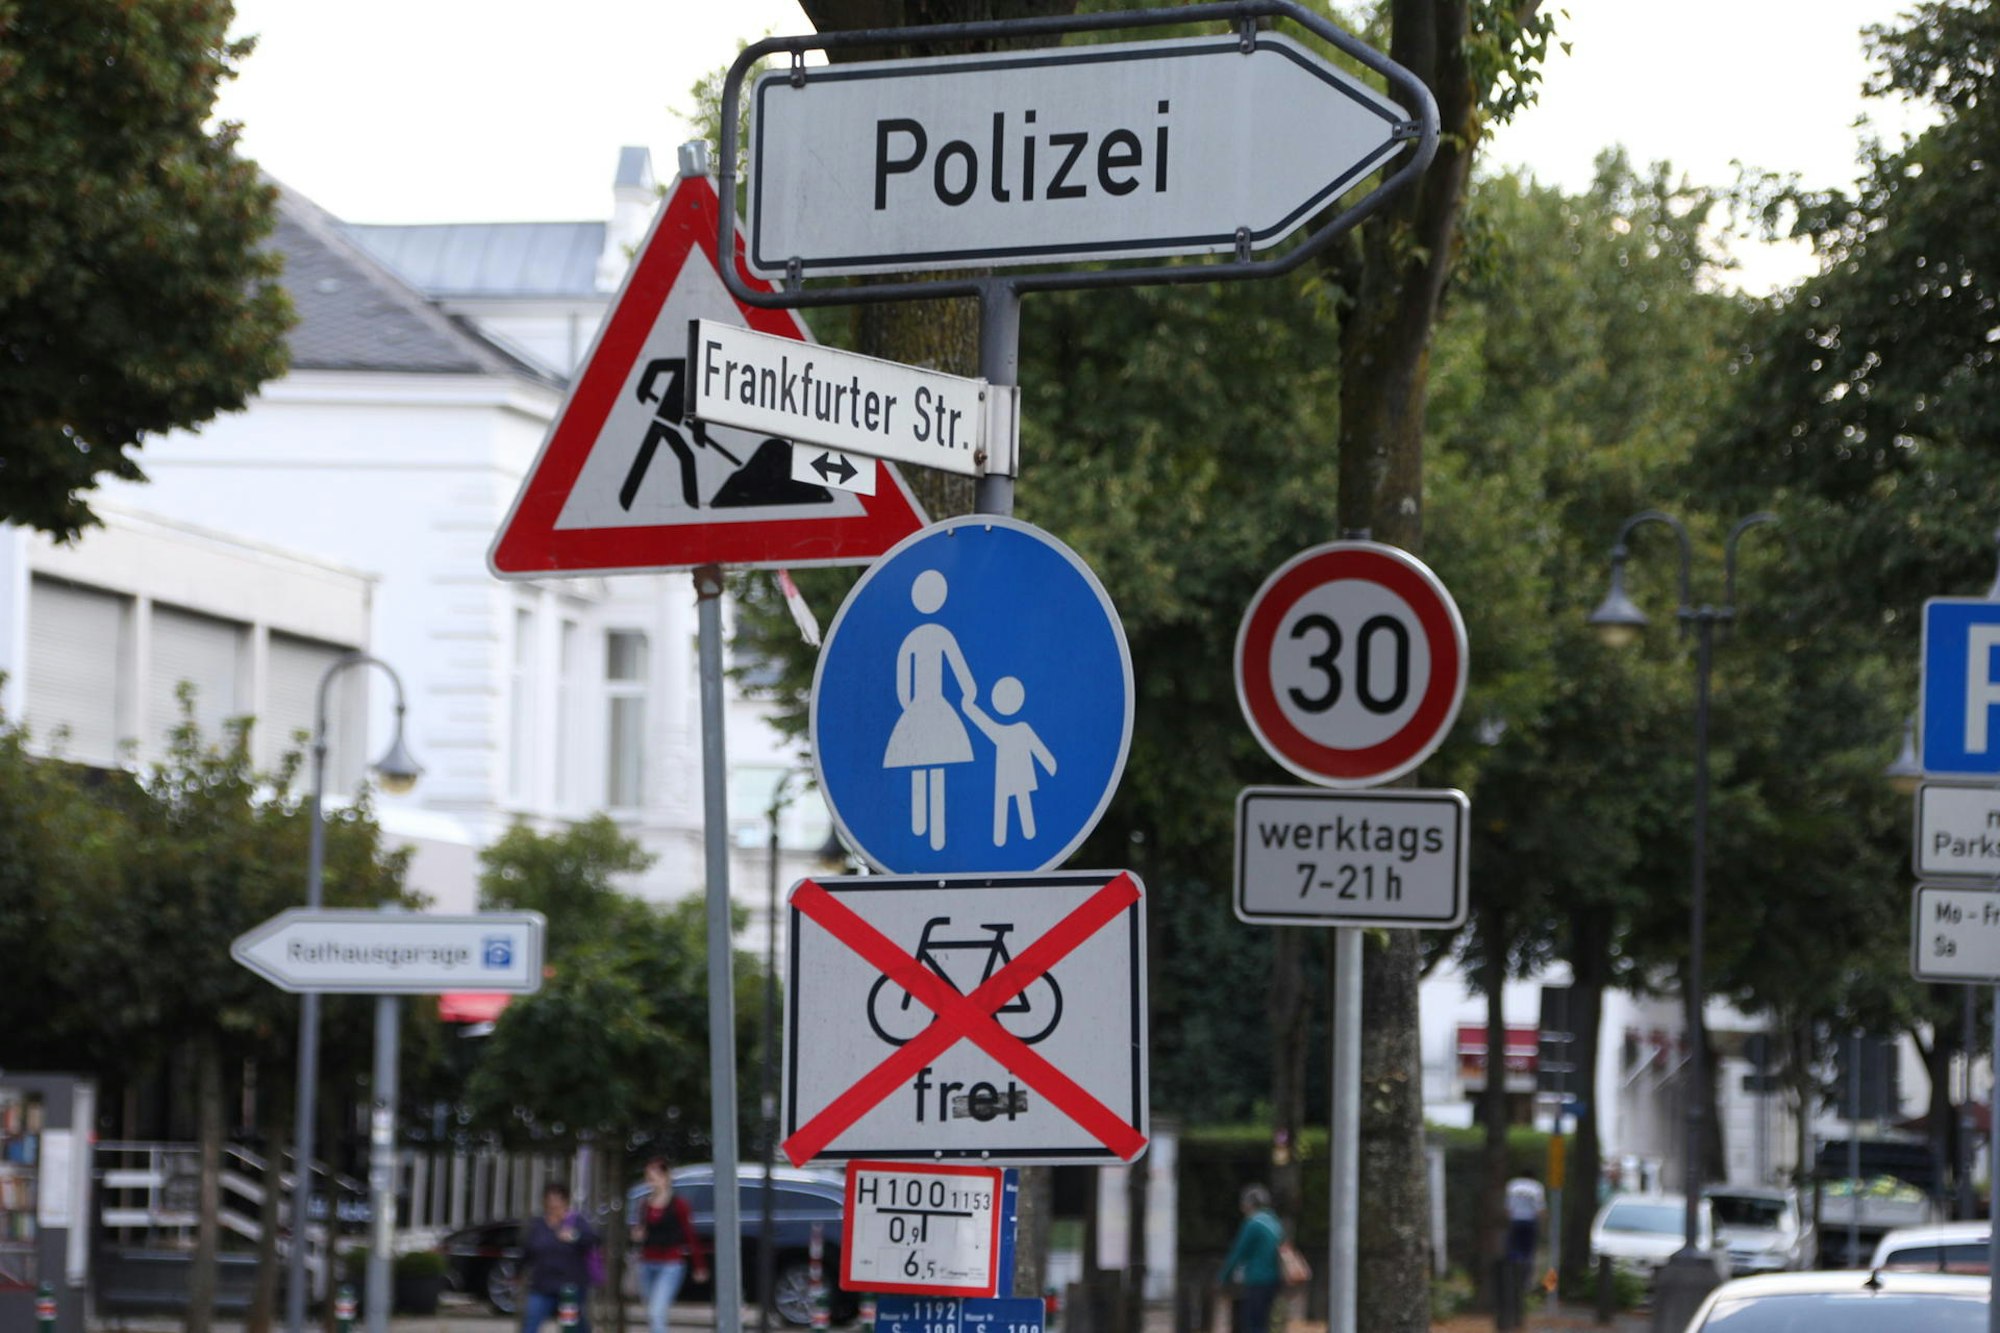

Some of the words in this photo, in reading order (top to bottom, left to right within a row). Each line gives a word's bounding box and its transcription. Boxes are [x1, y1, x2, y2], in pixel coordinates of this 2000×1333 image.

[875, 100, 1169, 210] Polizei
[704, 340, 897, 436] Frankfurter
[913, 386, 969, 451] Str.
[1288, 614, 1409, 714] 30
[1259, 816, 1444, 861] werktags
[1386, 865, 1402, 901] h
[1935, 902, 1963, 925] Mo
[1934, 933, 1957, 958] Sa
[913, 1067, 1017, 1122] frei
[952, 1191, 991, 1211] 1153
[913, 1301, 956, 1321] 1192
